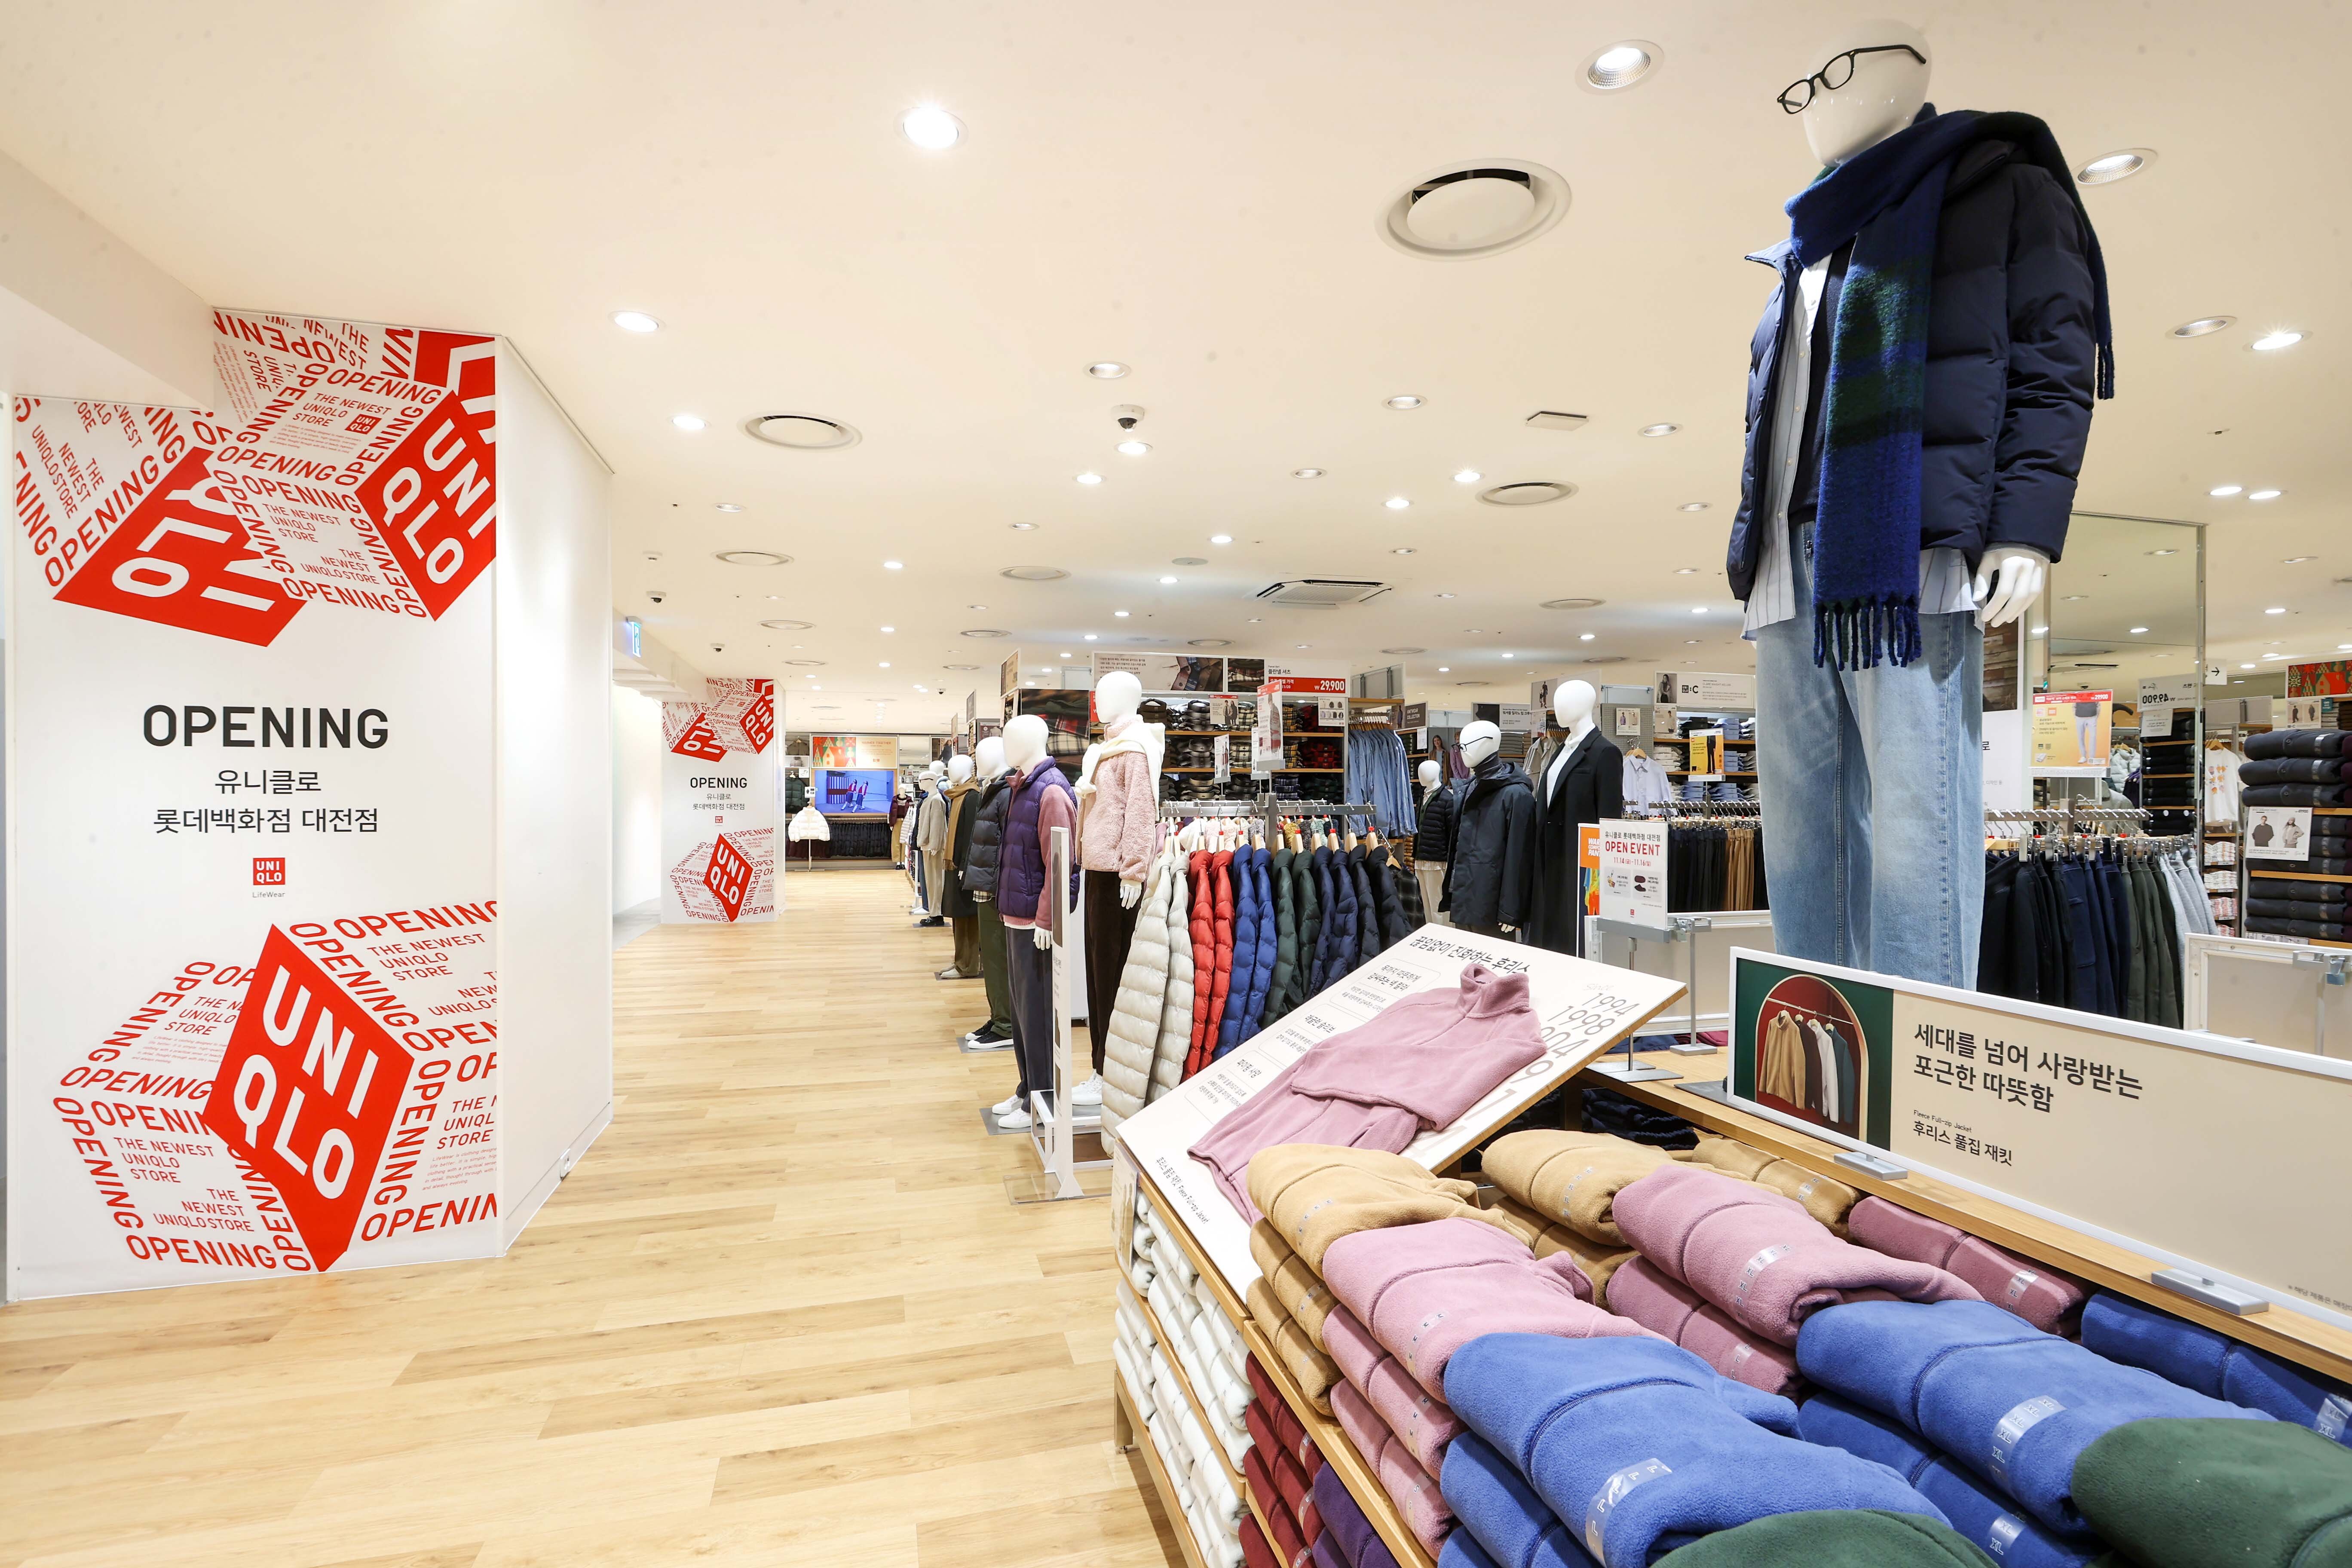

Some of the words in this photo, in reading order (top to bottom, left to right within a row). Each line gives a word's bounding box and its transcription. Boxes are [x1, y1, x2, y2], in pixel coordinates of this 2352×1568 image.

[327, 369, 441, 404] OPENING
[236, 363, 329, 444] OPENING
[303, 403, 348, 418] UNIQLO
[313, 393, 340, 404] THE
[339, 399, 392, 415] NEWEST
[293, 413, 334, 427] STORE
[335, 407, 424, 486] OPENING
[59, 442, 91, 502] NEWEST
[217, 446, 337, 481] OPENING
[86, 458, 104, 491] THE
[242, 475, 361, 514] OPENING
[45, 455, 159, 587] OPENING
[213, 470, 294, 574] OPENING
[262, 503, 290, 515] THE
[291, 508, 341, 526] NEWEST
[270, 515, 316, 531] UNIQLO
[279, 528, 318, 543] STORE
[320, 556, 370, 573] NEWEST
[339, 548, 365, 560] THE
[349, 517, 427, 618] OPENING
[283, 577, 400, 614] OPENING
[143, 704, 389, 749] OPENING
[214, 769, 322, 795] 유니클로
[690, 777, 747, 788] OPENING
[153, 808, 291, 834] 롯데백화점
[302, 808, 378, 833] 대전점
[1623, 833, 1645, 841] 롯데백화점
[1605, 841, 1628, 853] OPEN
[1630, 842, 1661, 856] EVENT
[367, 944, 408, 956] THE
[409, 934, 486, 952] NEWEST
[1409, 936, 1455, 955] 끊임없이
[1447, 946, 1493, 966] 진화하는
[380, 952, 449, 969] UNIQLO
[289, 923, 420, 1027] OPENING
[392, 965, 453, 981] STORE
[1396, 970, 1422, 983] 따뜻하게
[88, 961, 216, 1063] OPENING
[193, 996, 228, 1009] THE
[1582, 992, 1641, 1017] 1994
[179, 1008, 237, 1024] UNIQLO
[1547, 1005, 1615, 1036] 1998
[164, 1021, 217, 1036] STORE
[262, 964, 380, 1120] UNI
[1914, 1024, 1977, 1060] 세대를
[1984, 1038, 2029, 1072] 넘어
[2037, 1052, 2143, 1100] 사랑받는
[60, 1066, 216, 1100] OPENING
[1914, 1055, 1976, 1091] 포근한
[1983, 1072, 2055, 1113] 따뜻함
[452, 1096, 487, 1113] THE
[233, 1054, 355, 1200] QLO
[1913, 1109, 1930, 1120] Fleece
[1932, 1115, 1952, 1127] Full-zip
[1954, 1123, 1972, 1133] Jacket
[374, 1060, 451, 1206] OPENING
[436, 1129, 494, 1150] STORE
[113, 1137, 147, 1151] THE
[150, 1140, 215, 1158] NEWEST
[1913, 1121, 1951, 1145] 후리스
[1954, 1133, 1981, 1156] 풀집
[1984, 1144, 2012, 1167] 재킷
[53, 1097, 144, 1229] OPENING
[121, 1152, 180, 1169] UNIQLO
[130, 1169, 181, 1183] STORE
[206, 1188, 239, 1201] THE
[181, 1200, 245, 1217] NEWEST
[126, 1234, 277, 1270] OPENING
[1746, 1268, 1754, 1277] XL
[1739, 1280, 1747, 1292] XL
[2008, 1288, 2018, 1298] XL
[1736, 1296, 1744, 1307] XL
[2025, 1403, 2040, 1416] XL
[2012, 1414, 2024, 1427] XL
[2317, 1423, 2336, 1439] XL
[1998, 1428, 2012, 1444] XL
[1992, 1446, 2005, 1464] XL
[1597, 1498, 1605, 1513] L
[1990, 1537, 2004, 1555] XL
